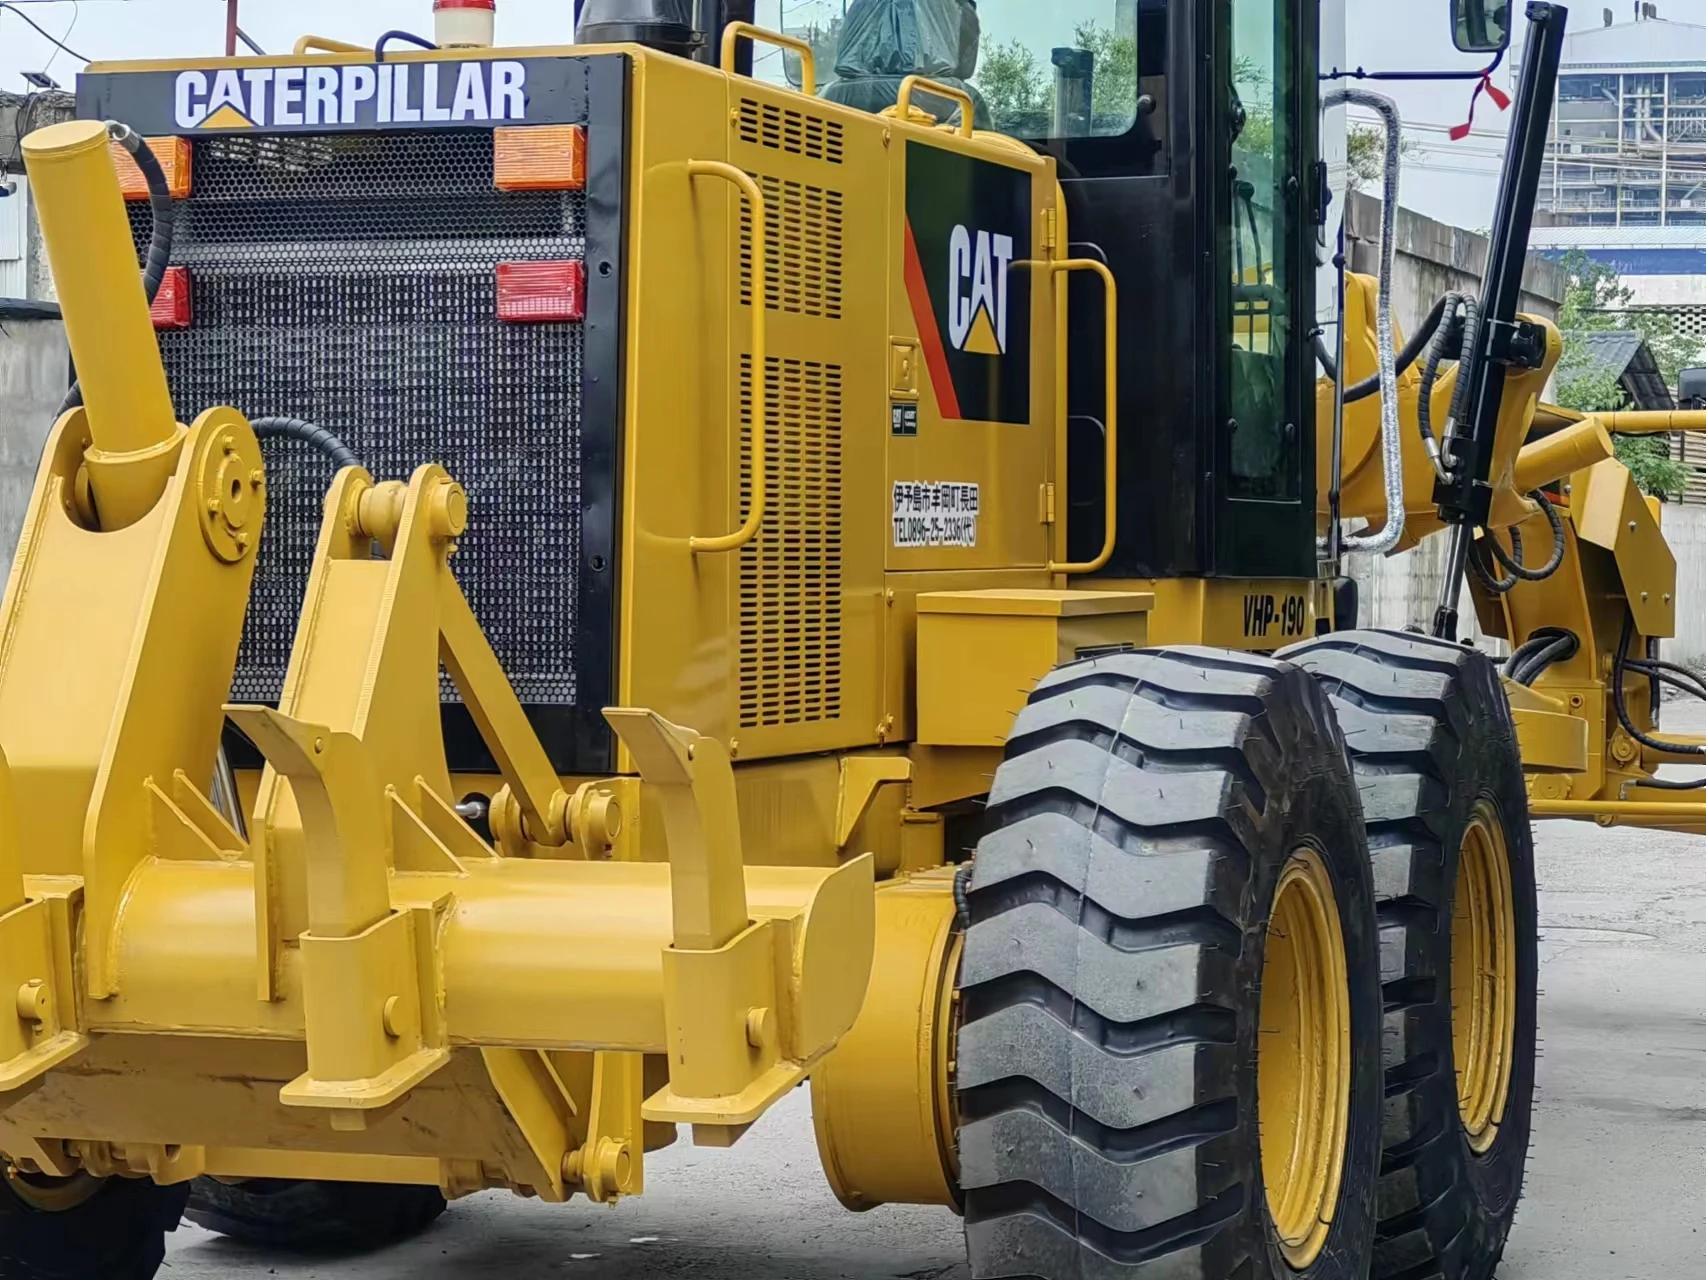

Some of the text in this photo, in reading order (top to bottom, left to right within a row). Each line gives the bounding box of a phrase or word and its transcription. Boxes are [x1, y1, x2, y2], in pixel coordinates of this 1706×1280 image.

[175, 61, 525, 128] CATERPILLAR
[949, 224, 1013, 354] CAT
[1243, 595, 1305, 637] VHP-190
